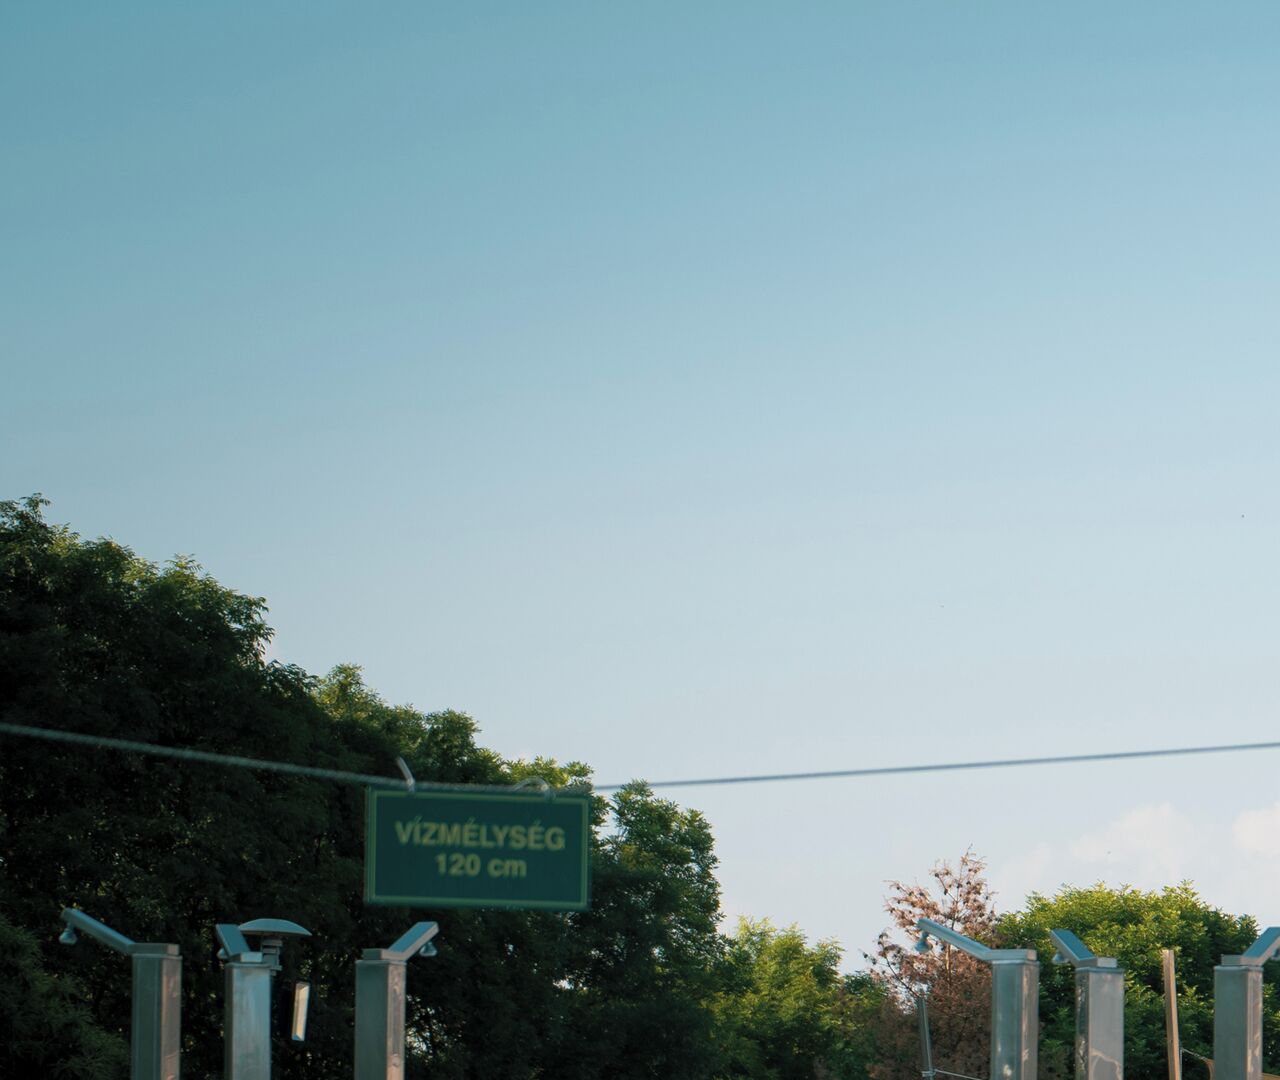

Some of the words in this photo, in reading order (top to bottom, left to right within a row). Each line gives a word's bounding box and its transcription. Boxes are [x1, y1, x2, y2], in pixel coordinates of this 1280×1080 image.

[394, 815, 566, 850] VÍZMÉLYSÉG
[435, 853, 481, 877] 120
[487, 857, 527, 878] cm
